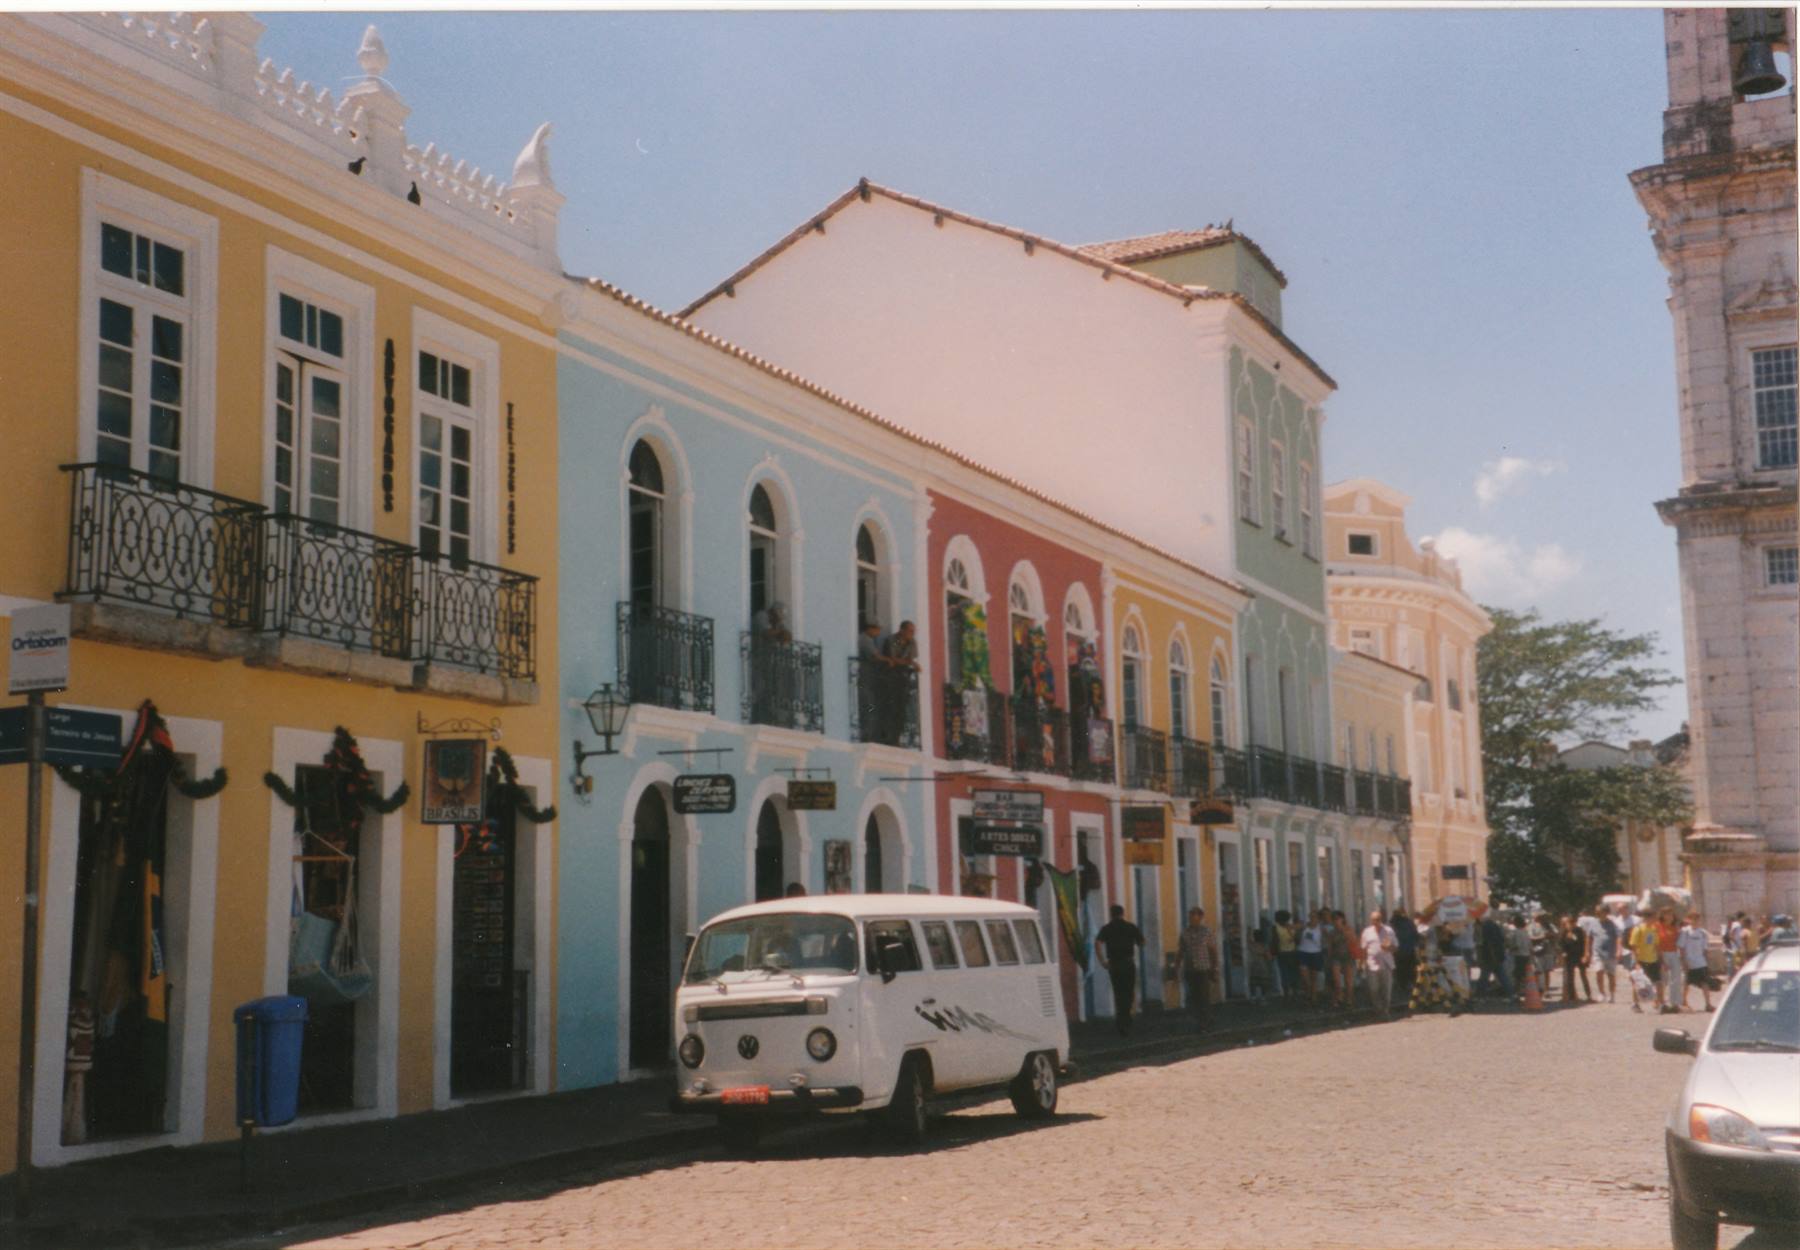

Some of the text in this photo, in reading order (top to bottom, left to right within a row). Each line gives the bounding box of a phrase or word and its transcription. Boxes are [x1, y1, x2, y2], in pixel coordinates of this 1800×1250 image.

[49, 713, 71, 723] Largo
[49, 727, 80, 738] Terreiro
[93, 732, 115, 741] Jesus
